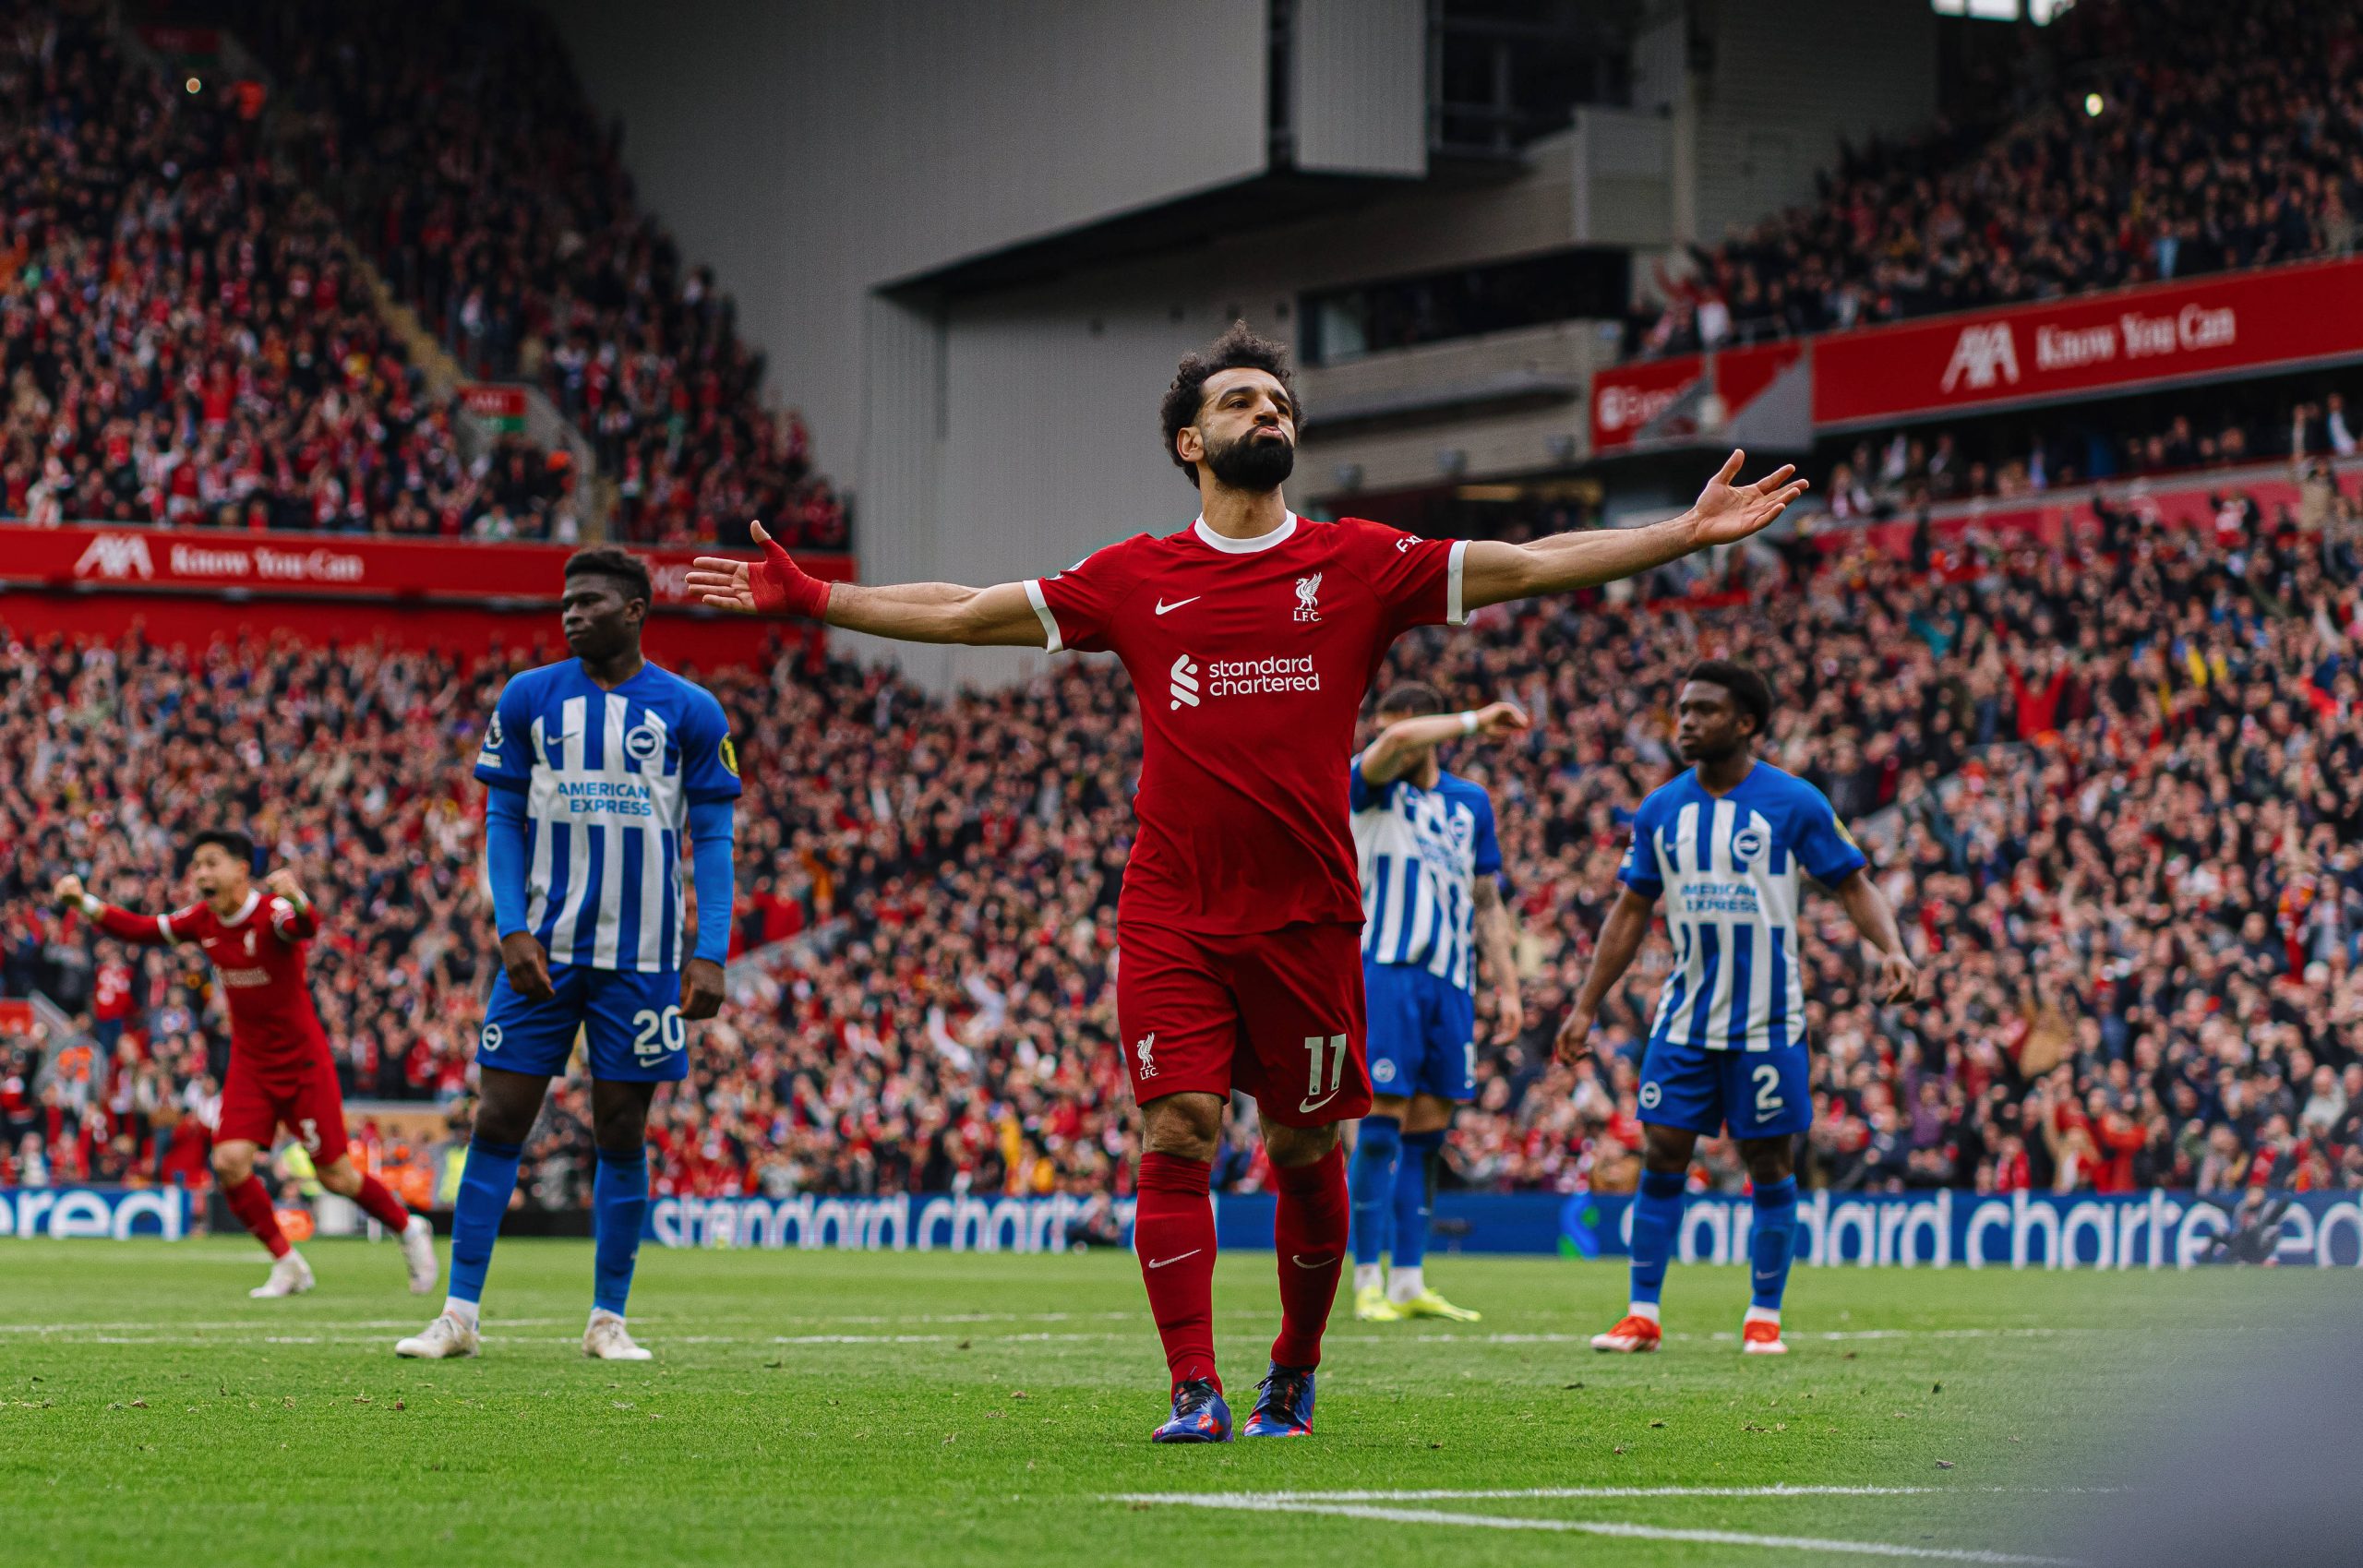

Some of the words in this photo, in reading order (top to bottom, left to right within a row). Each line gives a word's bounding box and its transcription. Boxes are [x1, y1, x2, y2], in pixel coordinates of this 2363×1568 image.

[1941, 320, 2020, 393] AXA
[2035, 324, 2115, 370] Know
[2120, 312, 2176, 359] You
[2177, 303, 2236, 351] Can
[74, 534, 154, 580] AXA
[171, 543, 250, 577] Know
[1209, 654, 1313, 678] standard
[1209, 673, 1320, 696] chartered
[558, 782, 651, 799] AMERICAN
[570, 799, 652, 816] EXPRESS
[633, 1004, 686, 1055] 20
[1304, 1033, 1347, 1095] 11
[1752, 1064, 1783, 1110] 2
[0, 1185, 182, 1241] red
[653, 1191, 909, 1251] standard
